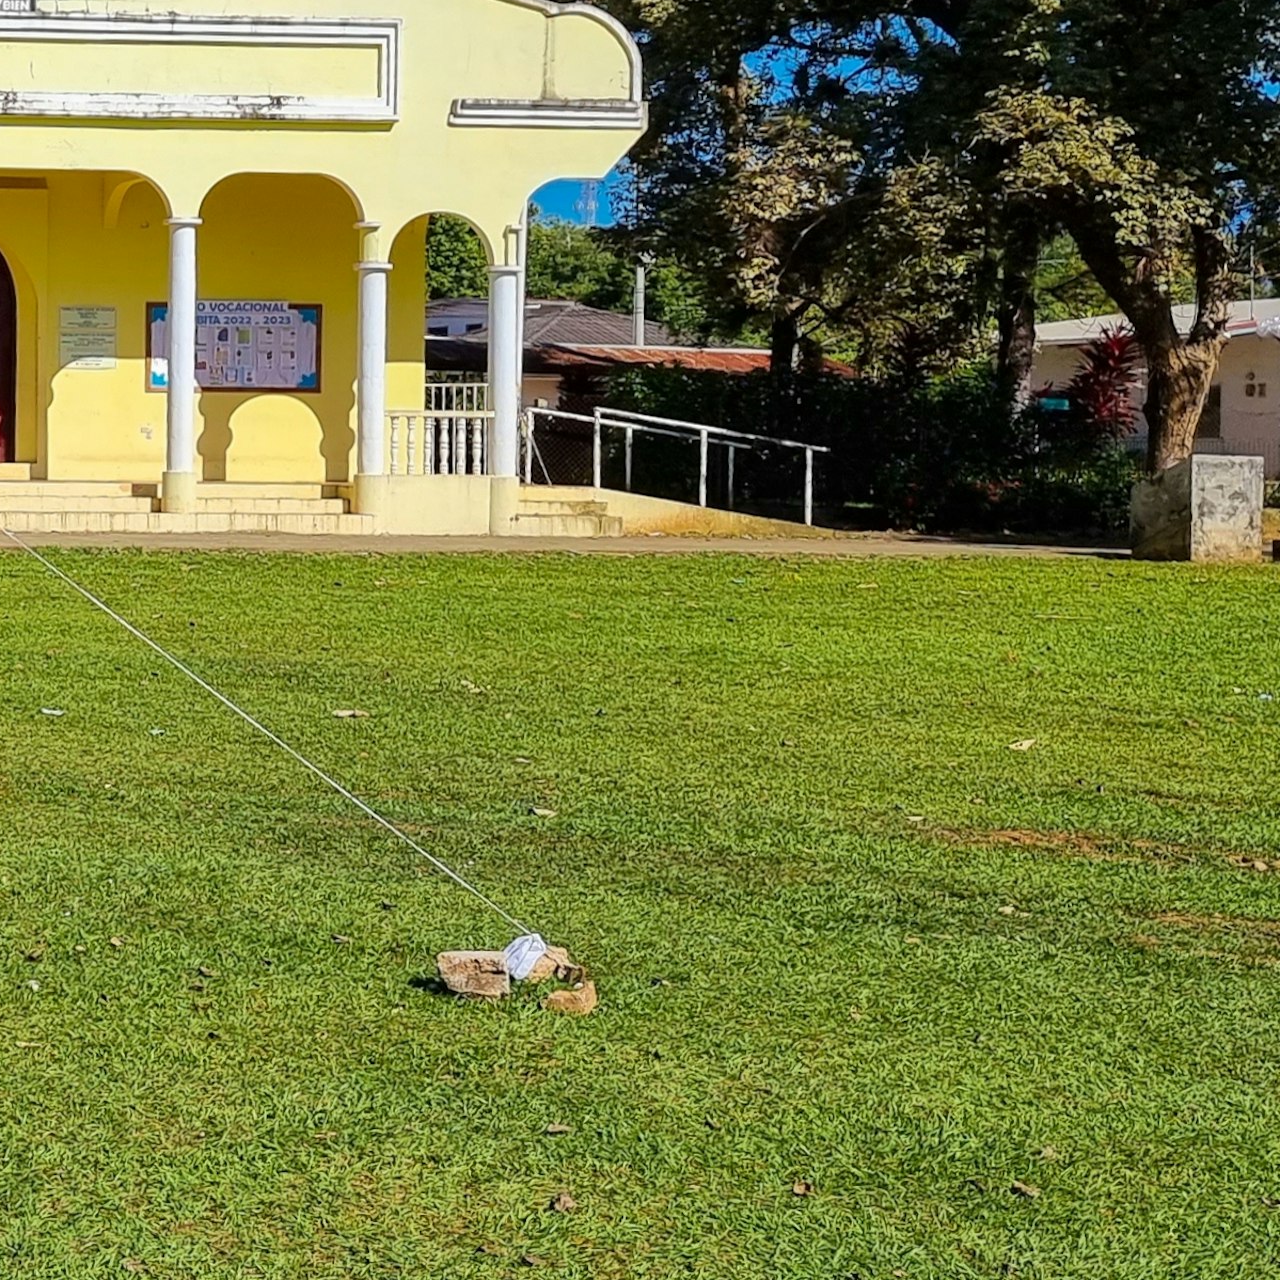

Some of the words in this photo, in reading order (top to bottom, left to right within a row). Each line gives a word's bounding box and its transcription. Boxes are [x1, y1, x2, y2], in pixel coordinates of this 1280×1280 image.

[209, 302, 287, 313] VOCACIONAL
[223, 315, 252, 325] 2022
[263, 315, 292, 325] 2023
